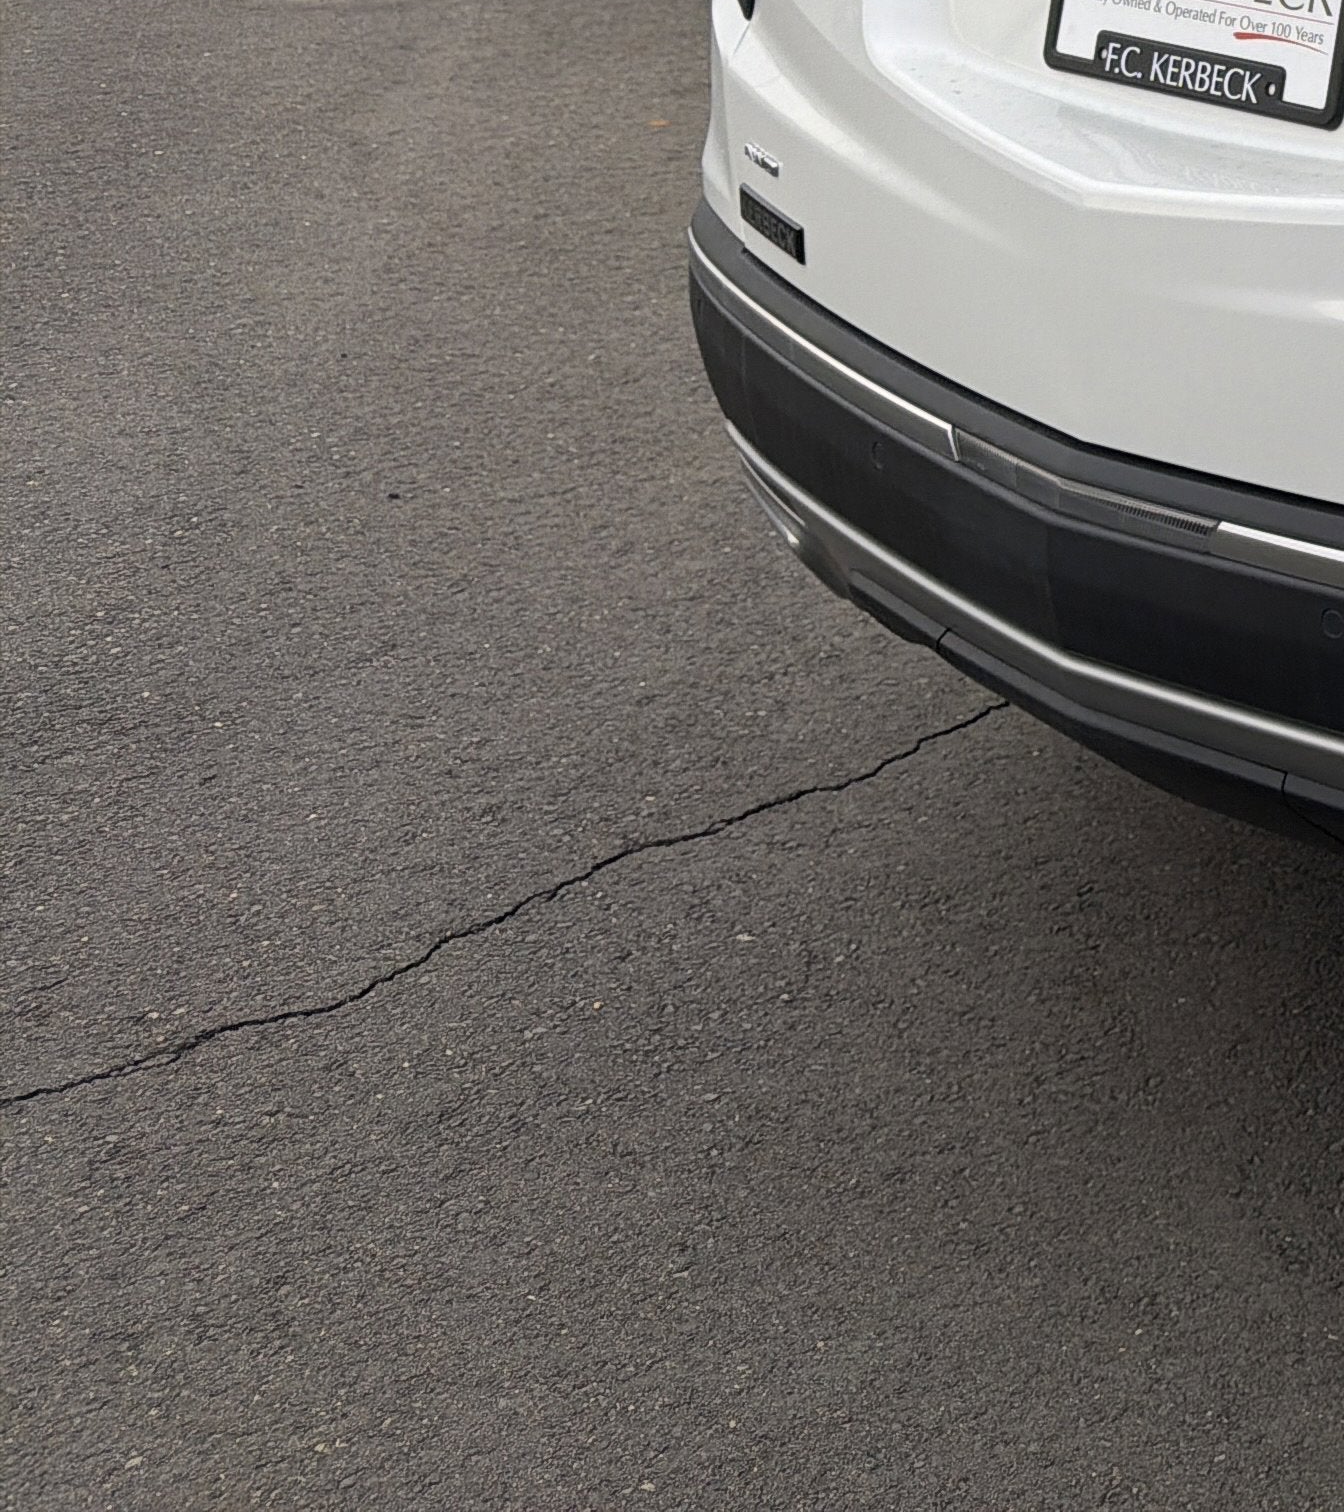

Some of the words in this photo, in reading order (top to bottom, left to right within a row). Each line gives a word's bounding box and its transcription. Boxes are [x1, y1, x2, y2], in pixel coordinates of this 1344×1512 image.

[1153, 0, 1164, 14] &
[1165, 0, 1218, 25] Operated
[1218, 10, 1238, 29] For
[1239, 15, 1269, 34] Over
[1270, 20, 1293, 39] 100
[1295, 25, 1325, 46] Years
[1103, 40, 1144, 80] F.C.
[1149, 50, 1262, 105] KERBECK
